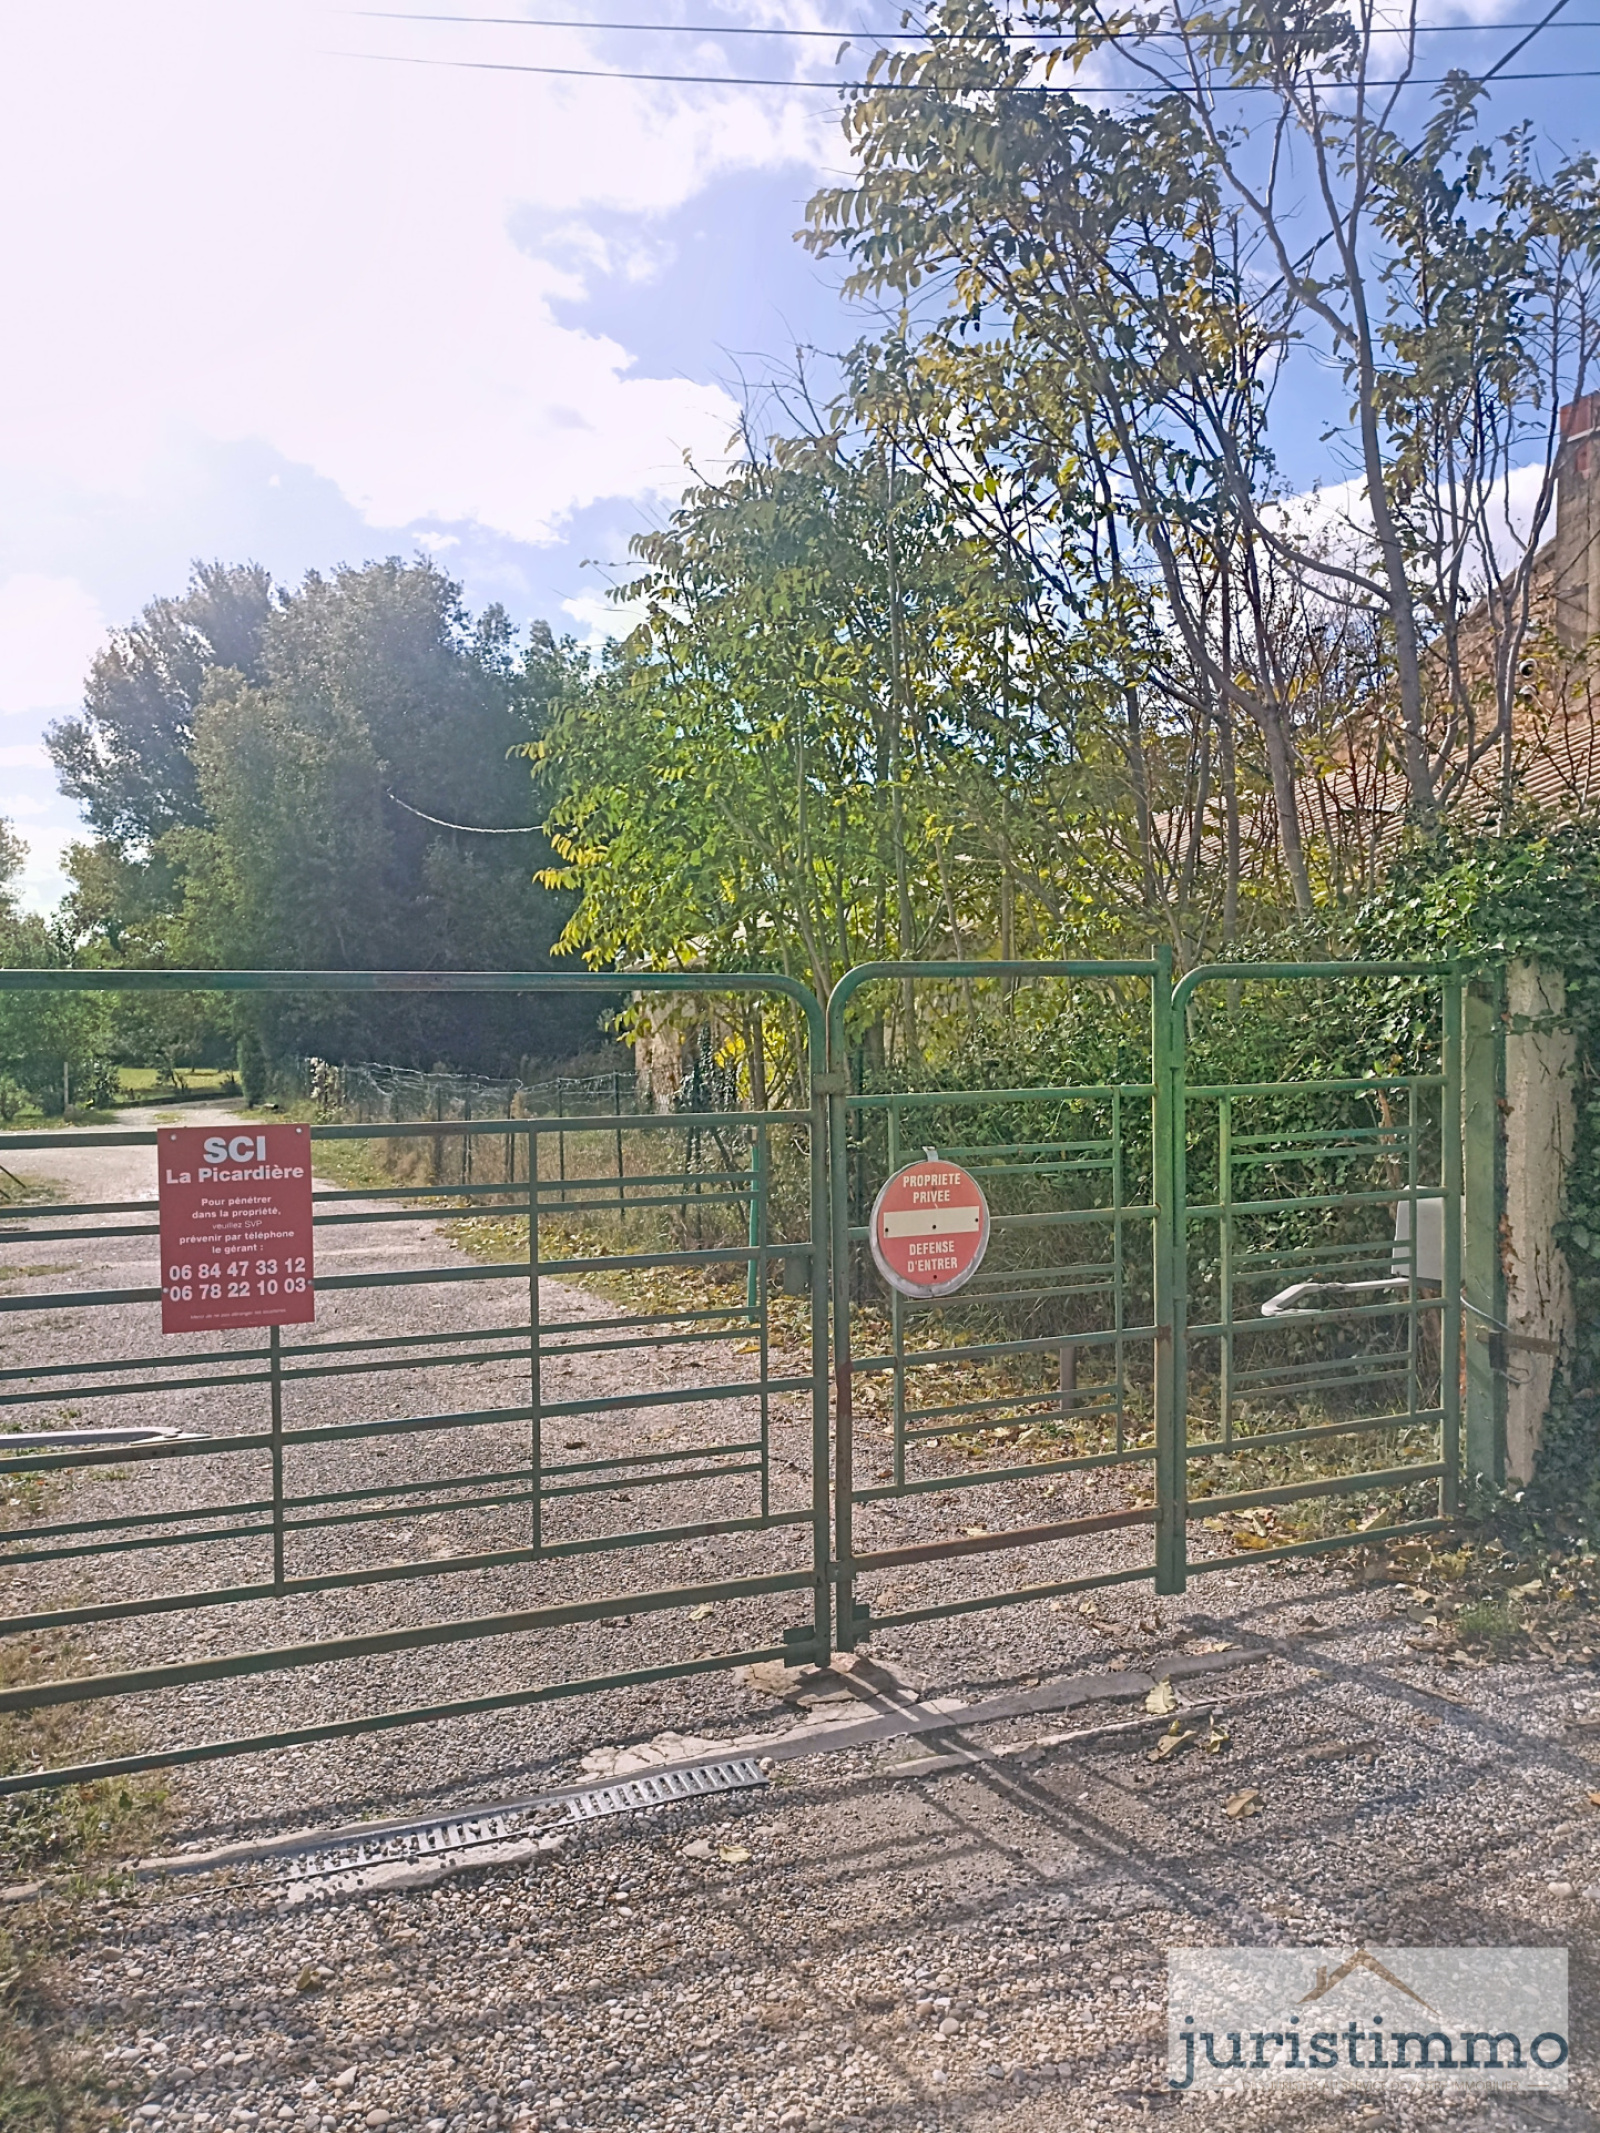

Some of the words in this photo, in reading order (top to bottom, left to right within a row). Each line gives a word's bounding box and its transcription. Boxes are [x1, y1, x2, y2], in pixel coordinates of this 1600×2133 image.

[203, 1135, 266, 1164] SCI
[166, 1168, 191, 1184] La
[198, 1164, 304, 1183] Picardière
[903, 1173, 961, 1188] PROPRIETE
[201, 1198, 225, 1206] Pour
[228, 1196, 272, 1207] pénétrer
[913, 1190, 950, 1203] PRIVEE
[192, 1210, 217, 1219] dans
[219, 1209, 229, 1218] la
[212, 1221, 242, 1230] veuillez
[244, 1220, 263, 1228] SVP
[179, 1234, 221, 1245] prévenir
[225, 1234, 241, 1243] par
[244, 1230, 295, 1241] téléphone
[212, 1245, 221, 1254] le
[224, 1244, 257, 1255] gérant
[909, 1241, 955, 1256] DEFENSE
[169, 1264, 193, 1281] 06
[198, 1263, 222, 1279] 84
[226, 1261, 249, 1277] 47
[255, 1259, 278, 1275] 33
[284, 1257, 306, 1273] 12
[907, 1257, 958, 1273] D'ENTRER
[169, 1285, 193, 1302] 06
[199, 1283, 222, 1300] 78
[227, 1281, 250, 1298] 22
[257, 1279, 278, 1296] 10
[284, 1277, 306, 1293] 03
